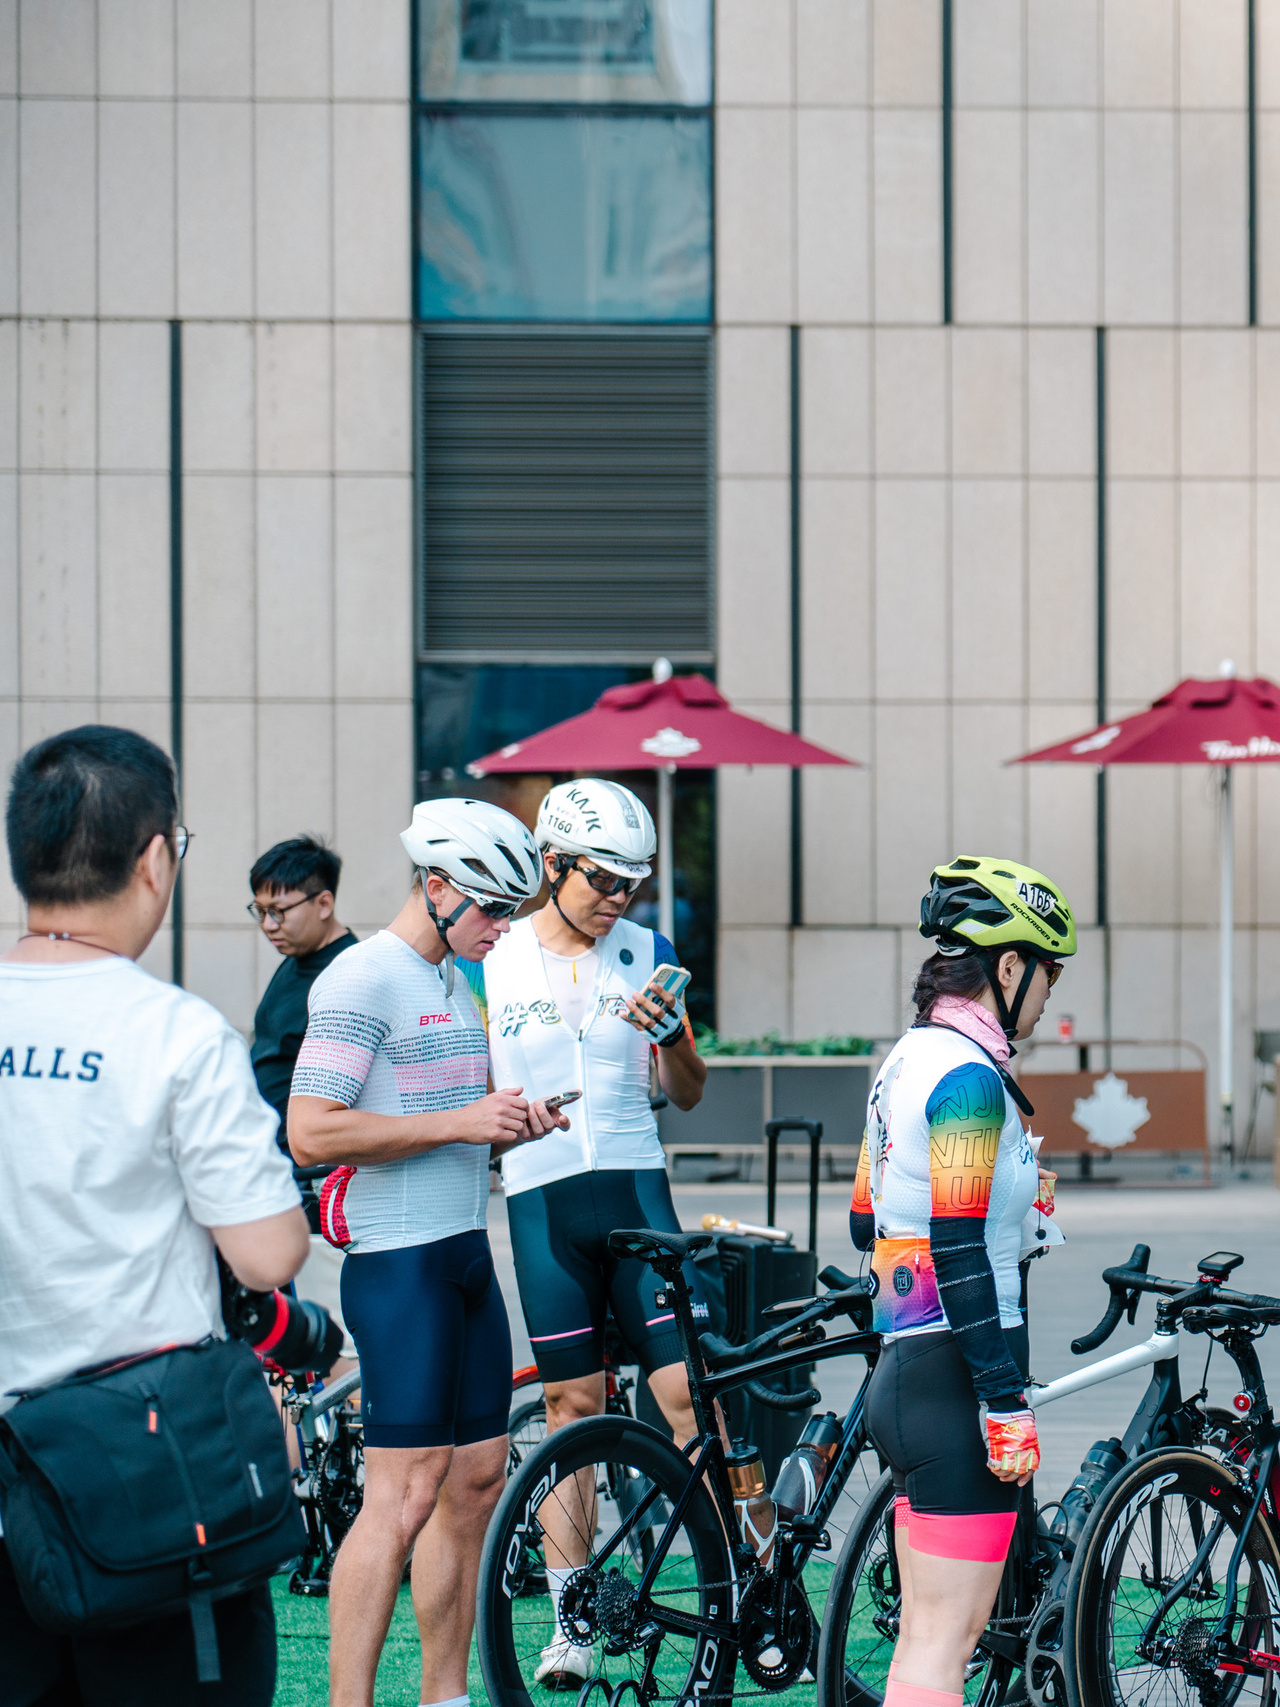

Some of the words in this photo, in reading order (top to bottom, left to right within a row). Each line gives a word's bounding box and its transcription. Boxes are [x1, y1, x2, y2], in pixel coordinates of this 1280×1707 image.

[548, 814, 573, 834] 1160
[566, 788, 602, 833] KASK
[1010, 902, 1051, 941] ROCKRIDER
[419, 1013, 453, 1026] BTAC
[0, 1045, 104, 1082] ALLS
[502, 1461, 557, 1600] roval
[1101, 1472, 1179, 1581] ZIPP
